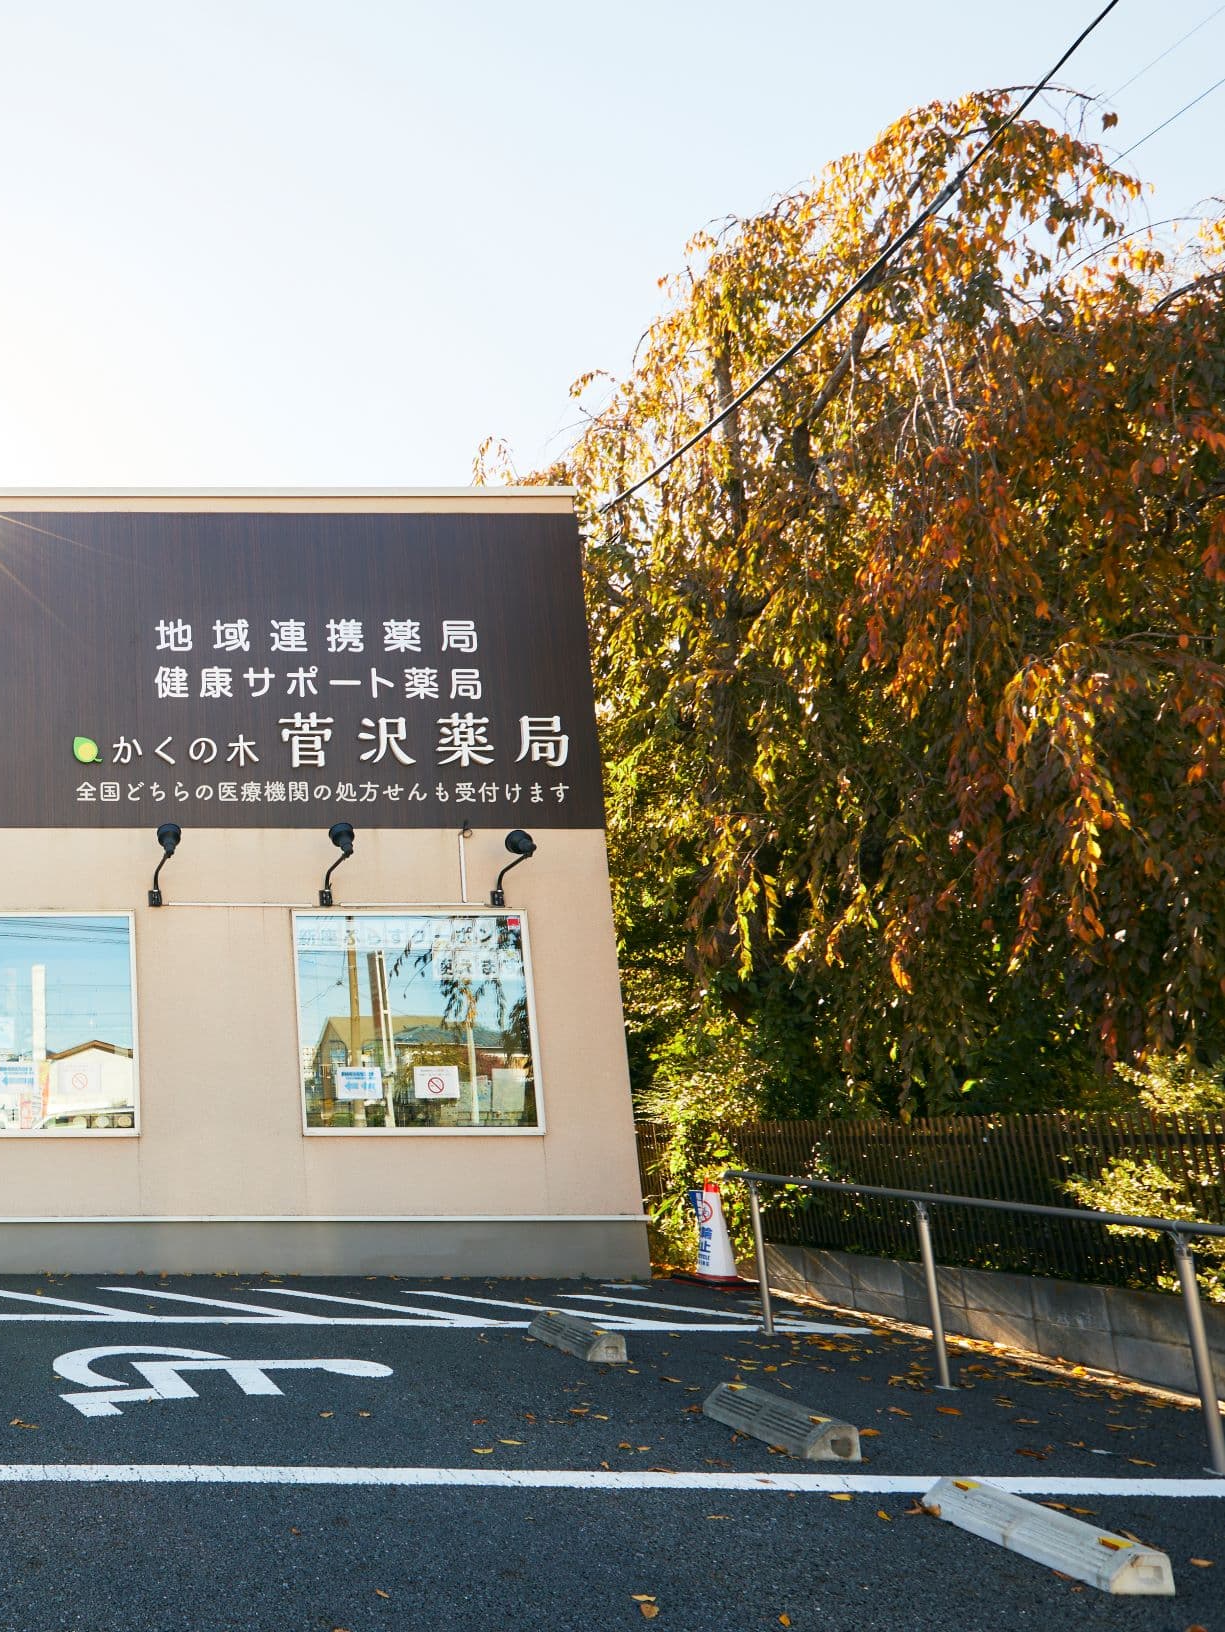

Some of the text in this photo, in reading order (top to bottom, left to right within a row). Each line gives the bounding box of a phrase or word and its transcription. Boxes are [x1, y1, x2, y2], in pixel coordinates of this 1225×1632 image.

[155, 619, 478, 653] 地域連携薬局
[154, 665, 482, 700] 健康サポート薬局
[112, 711, 570, 768] かくの木 菅沢薬局
[75, 780, 570, 803] 全国どちらの医療機関の処方せんも受付けます
